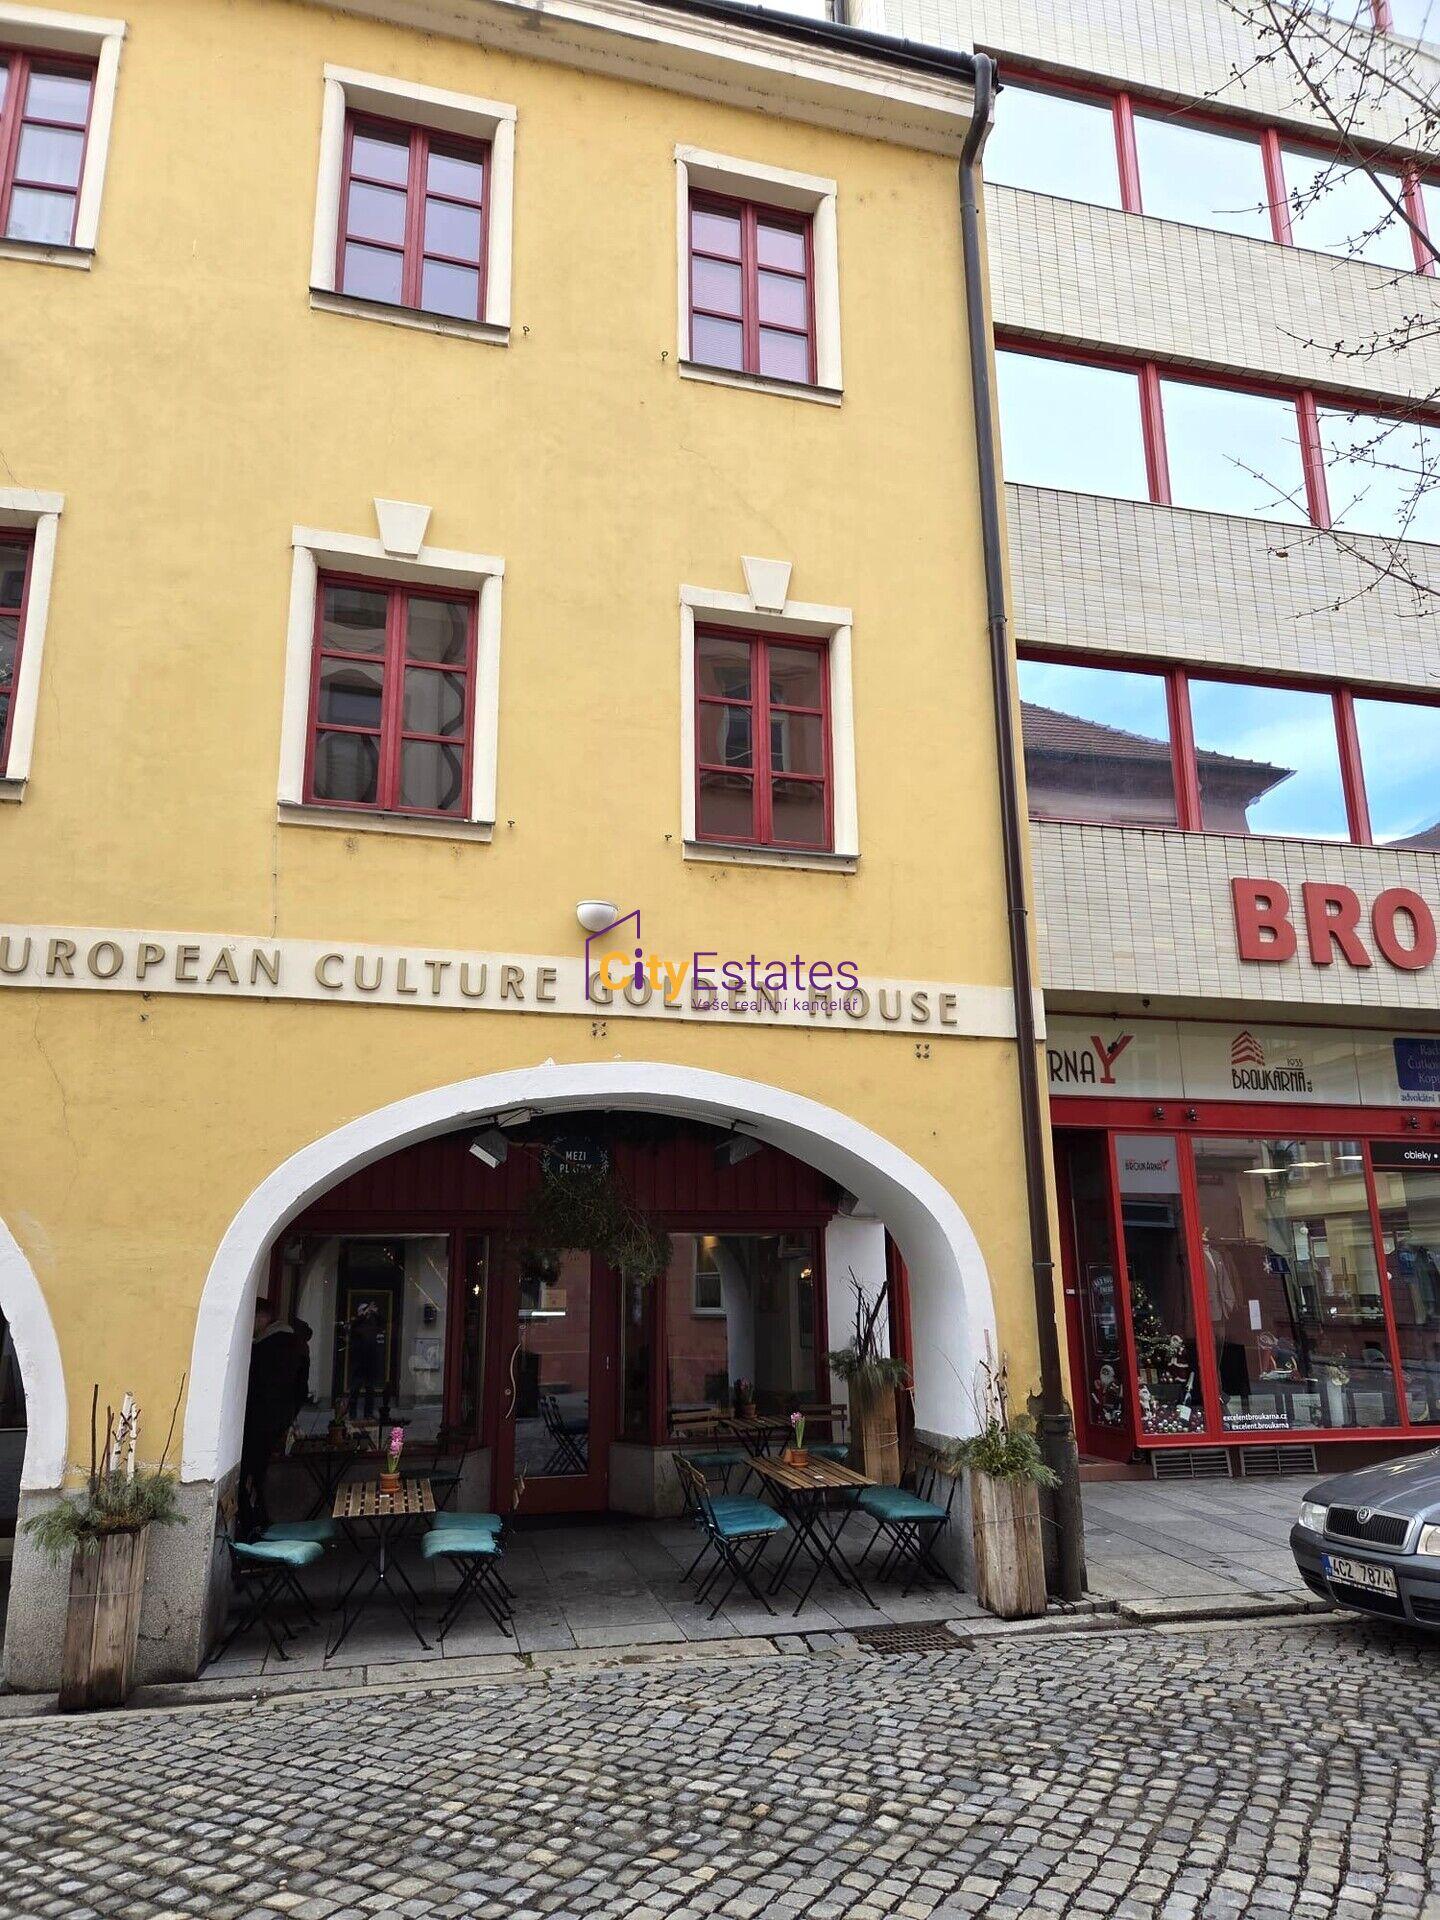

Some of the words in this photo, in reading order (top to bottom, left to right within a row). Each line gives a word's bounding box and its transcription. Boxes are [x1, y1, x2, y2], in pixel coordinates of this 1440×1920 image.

[1231, 877, 1437, 970] BRO
[314, 953, 558, 1001] CULTURE
[589, 968, 780, 1015] GOLDEN
[808, 983, 959, 1026] HOUSE
[566, 1151, 587, 1161] MEZI
[1359, 1564, 1392, 1588] 7874
